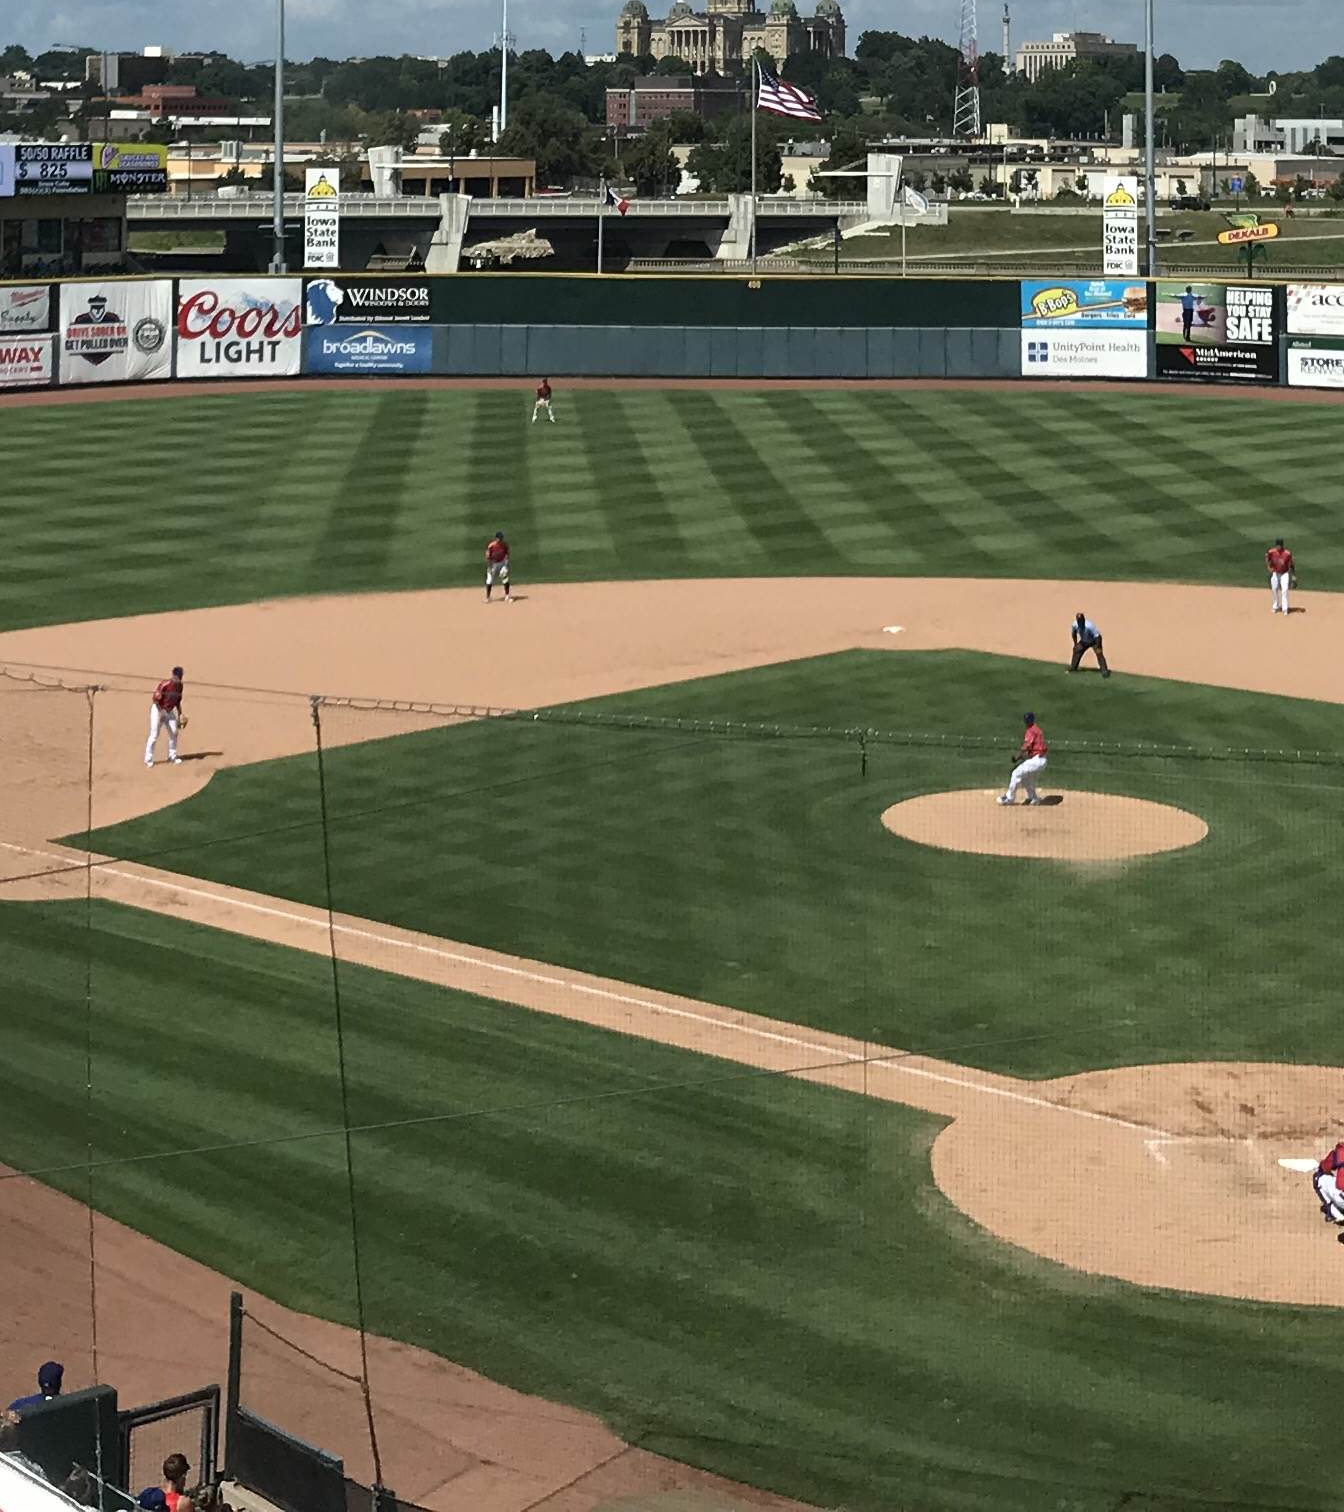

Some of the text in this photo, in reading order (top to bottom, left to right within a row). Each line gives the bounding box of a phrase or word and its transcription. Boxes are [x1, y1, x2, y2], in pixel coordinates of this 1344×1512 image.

[50, 146, 89, 160] RAFFLE
[306, 216, 337, 226] Iowa
[306, 227, 337, 238] State
[1105, 223, 1136, 234] Iowa
[306, 238, 337, 248] Bank
[1105, 234, 1136, 246] State
[1105, 245, 1136, 256] Bank
[347, 288, 429, 307] WINDSOR
[1226, 290, 1273, 306] HELPING
[179, 290, 302, 341] Coors
[1226, 305, 1272, 318] YOU STAY
[1226, 316, 1273, 342] SAFE
[65, 337, 129, 351] GET PULLED OVER
[323, 337, 416, 354] broadlawns
[1052, 342, 1141, 354] UnityPoint Health
[199, 340, 282, 363] LIGHT
[1196, 348, 1257, 359] MidAmerican
